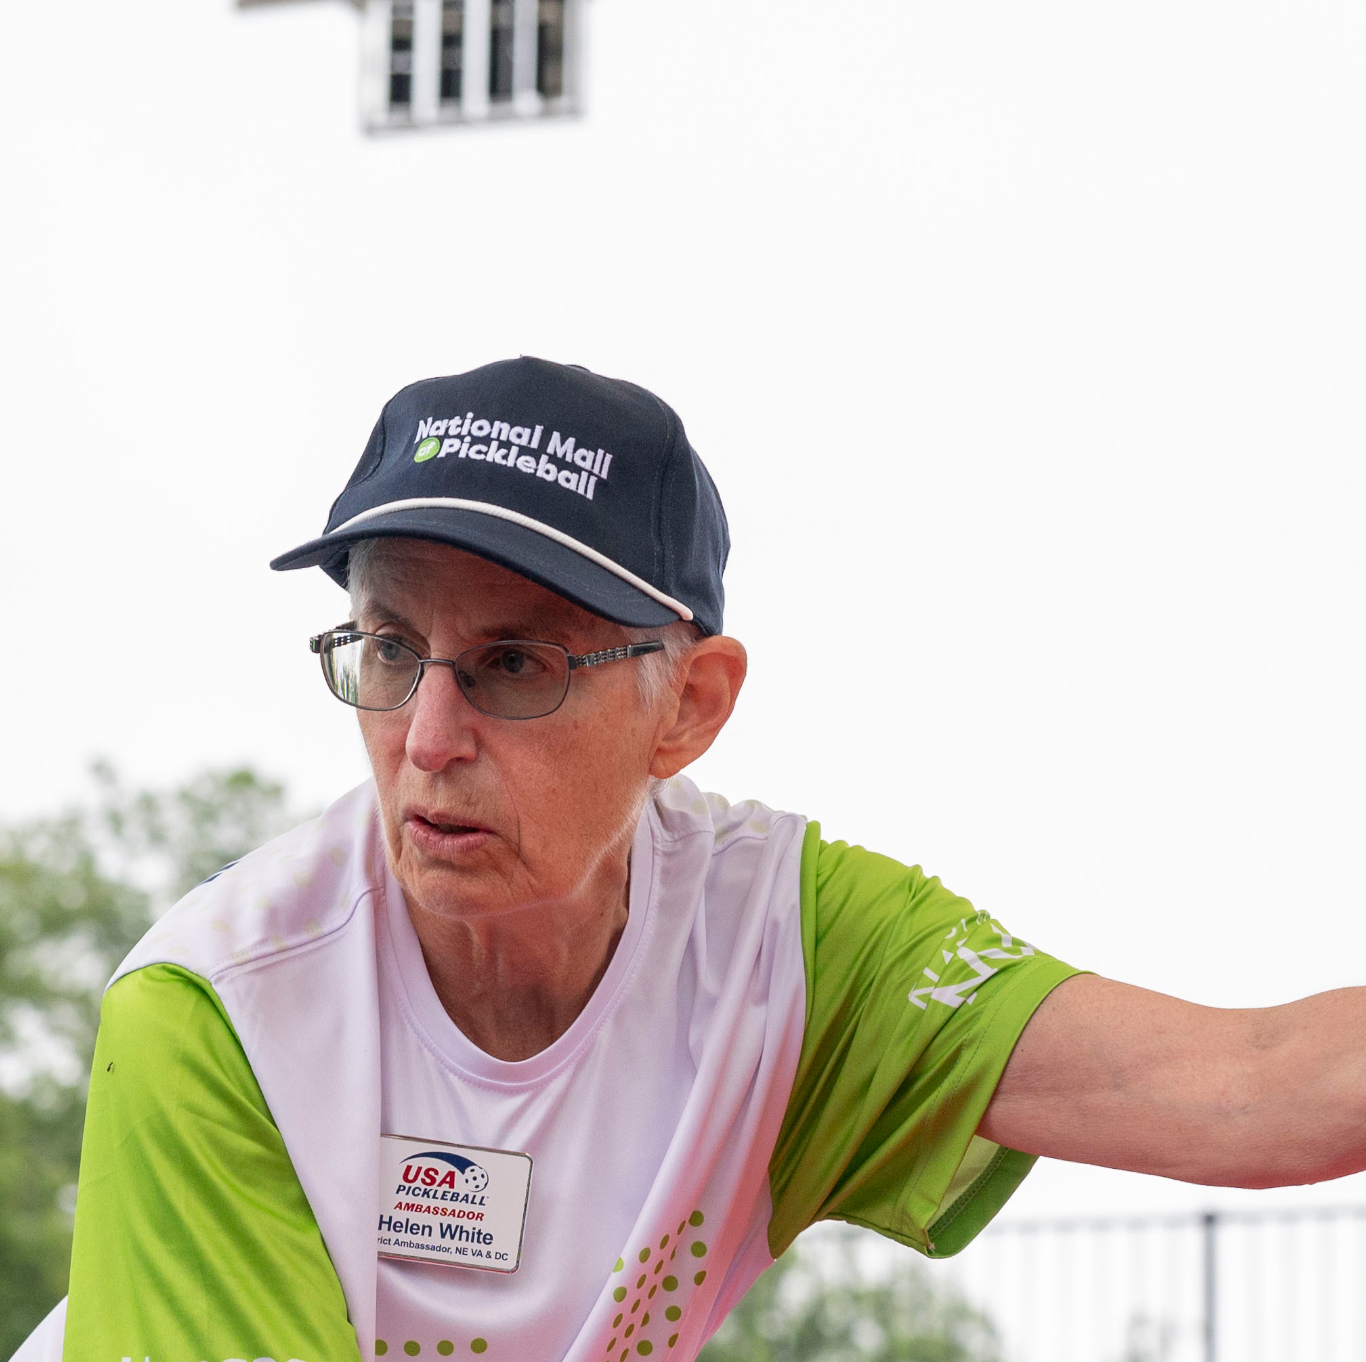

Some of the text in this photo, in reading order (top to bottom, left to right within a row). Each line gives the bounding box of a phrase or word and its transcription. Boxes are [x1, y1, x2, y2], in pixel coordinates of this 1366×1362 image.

[414, 412, 613, 480] National Mall
[417, 436, 598, 500] of Pickleball
[402, 1164, 456, 1189] USA
[395, 1184, 486, 1206] PICKLEBALL
[393, 1201, 485, 1222] AMBASSADOR
[377, 1214, 494, 1246] Helen White
[393, 1238, 453, 1255] Ambassador,
[455, 1246, 468, 1256] NE
[471, 1249, 484, 1258] VA
[485, 1251, 493, 1259] &
[494, 1252, 509, 1261] DC
